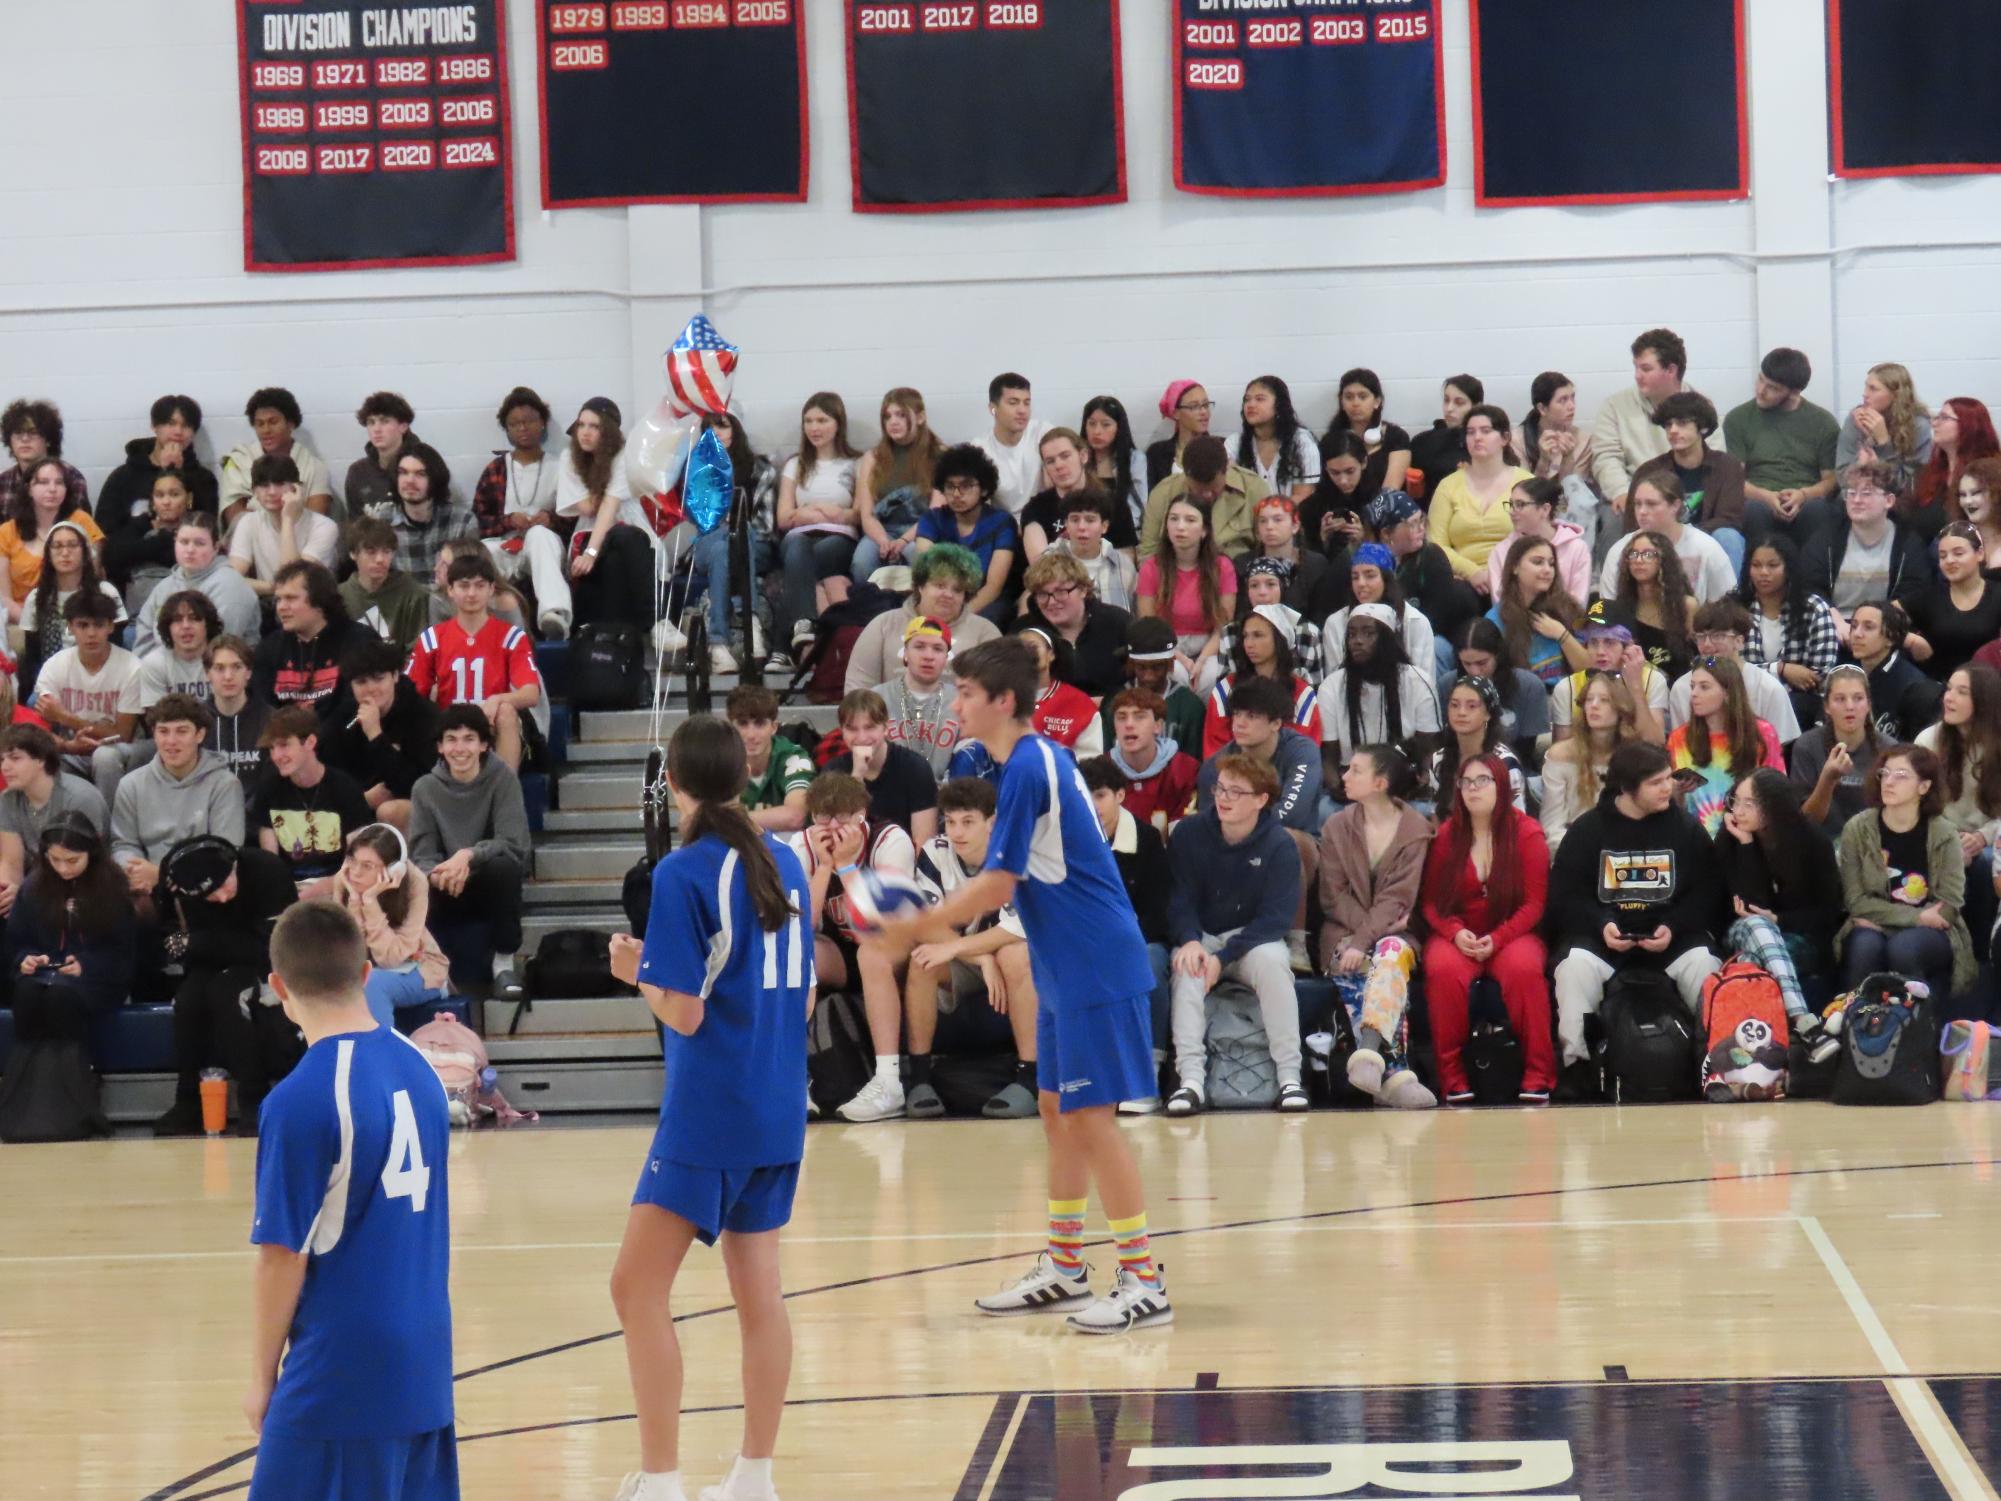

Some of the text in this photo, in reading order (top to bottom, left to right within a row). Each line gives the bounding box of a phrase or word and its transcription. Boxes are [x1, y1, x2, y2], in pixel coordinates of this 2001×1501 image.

[263, 5, 476, 51] DIVISION CHAMPIONS
[553, 1, 787, 28] 1979 1993 1994 2005
[861, 4, 1038, 29] 2001 2017 2018
[1187, 16, 1427, 44] 2001 2002 2003 2015
[555, 45, 604, 66] 2006
[255, 58, 490, 86] 1969 1971 1982 1986
[1189, 63, 1239, 84] 2020
[257, 100, 493, 128] 1989 1999 2003 2006
[258, 142, 495, 169] 2008 2017 2020 2024
[277, 687, 333, 700] WASHINGTON
[451, 657, 491, 705] 11
[381, 1089, 430, 1213] 4
